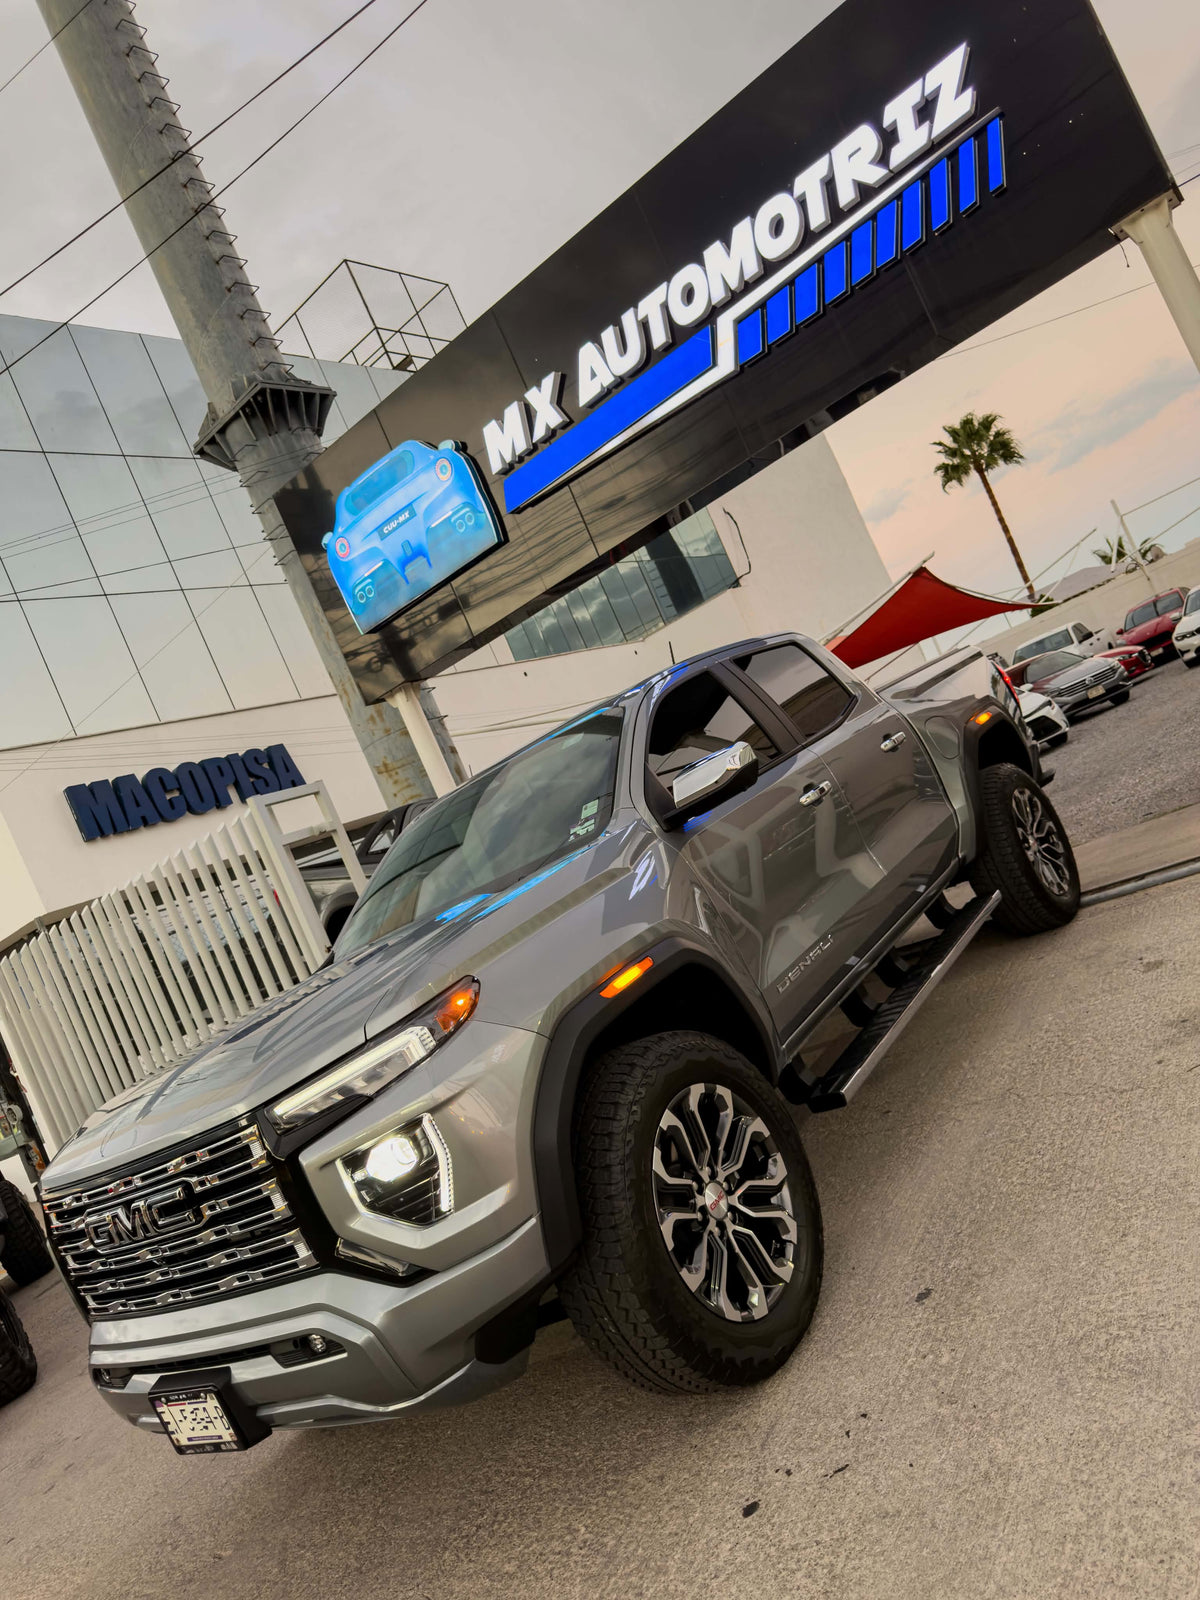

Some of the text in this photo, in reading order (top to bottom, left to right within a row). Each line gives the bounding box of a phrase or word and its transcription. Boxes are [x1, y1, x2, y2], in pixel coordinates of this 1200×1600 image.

[482, 42, 976, 475] MX AUTOMOTRIZ
[383, 510, 410, 534] CUU-MX
[64, 743, 307, 842] MACOPISA
[777, 934, 834, 994] DENALI
[85, 1184, 196, 1249] GMC
[709, 1190, 725, 1211] GMC
